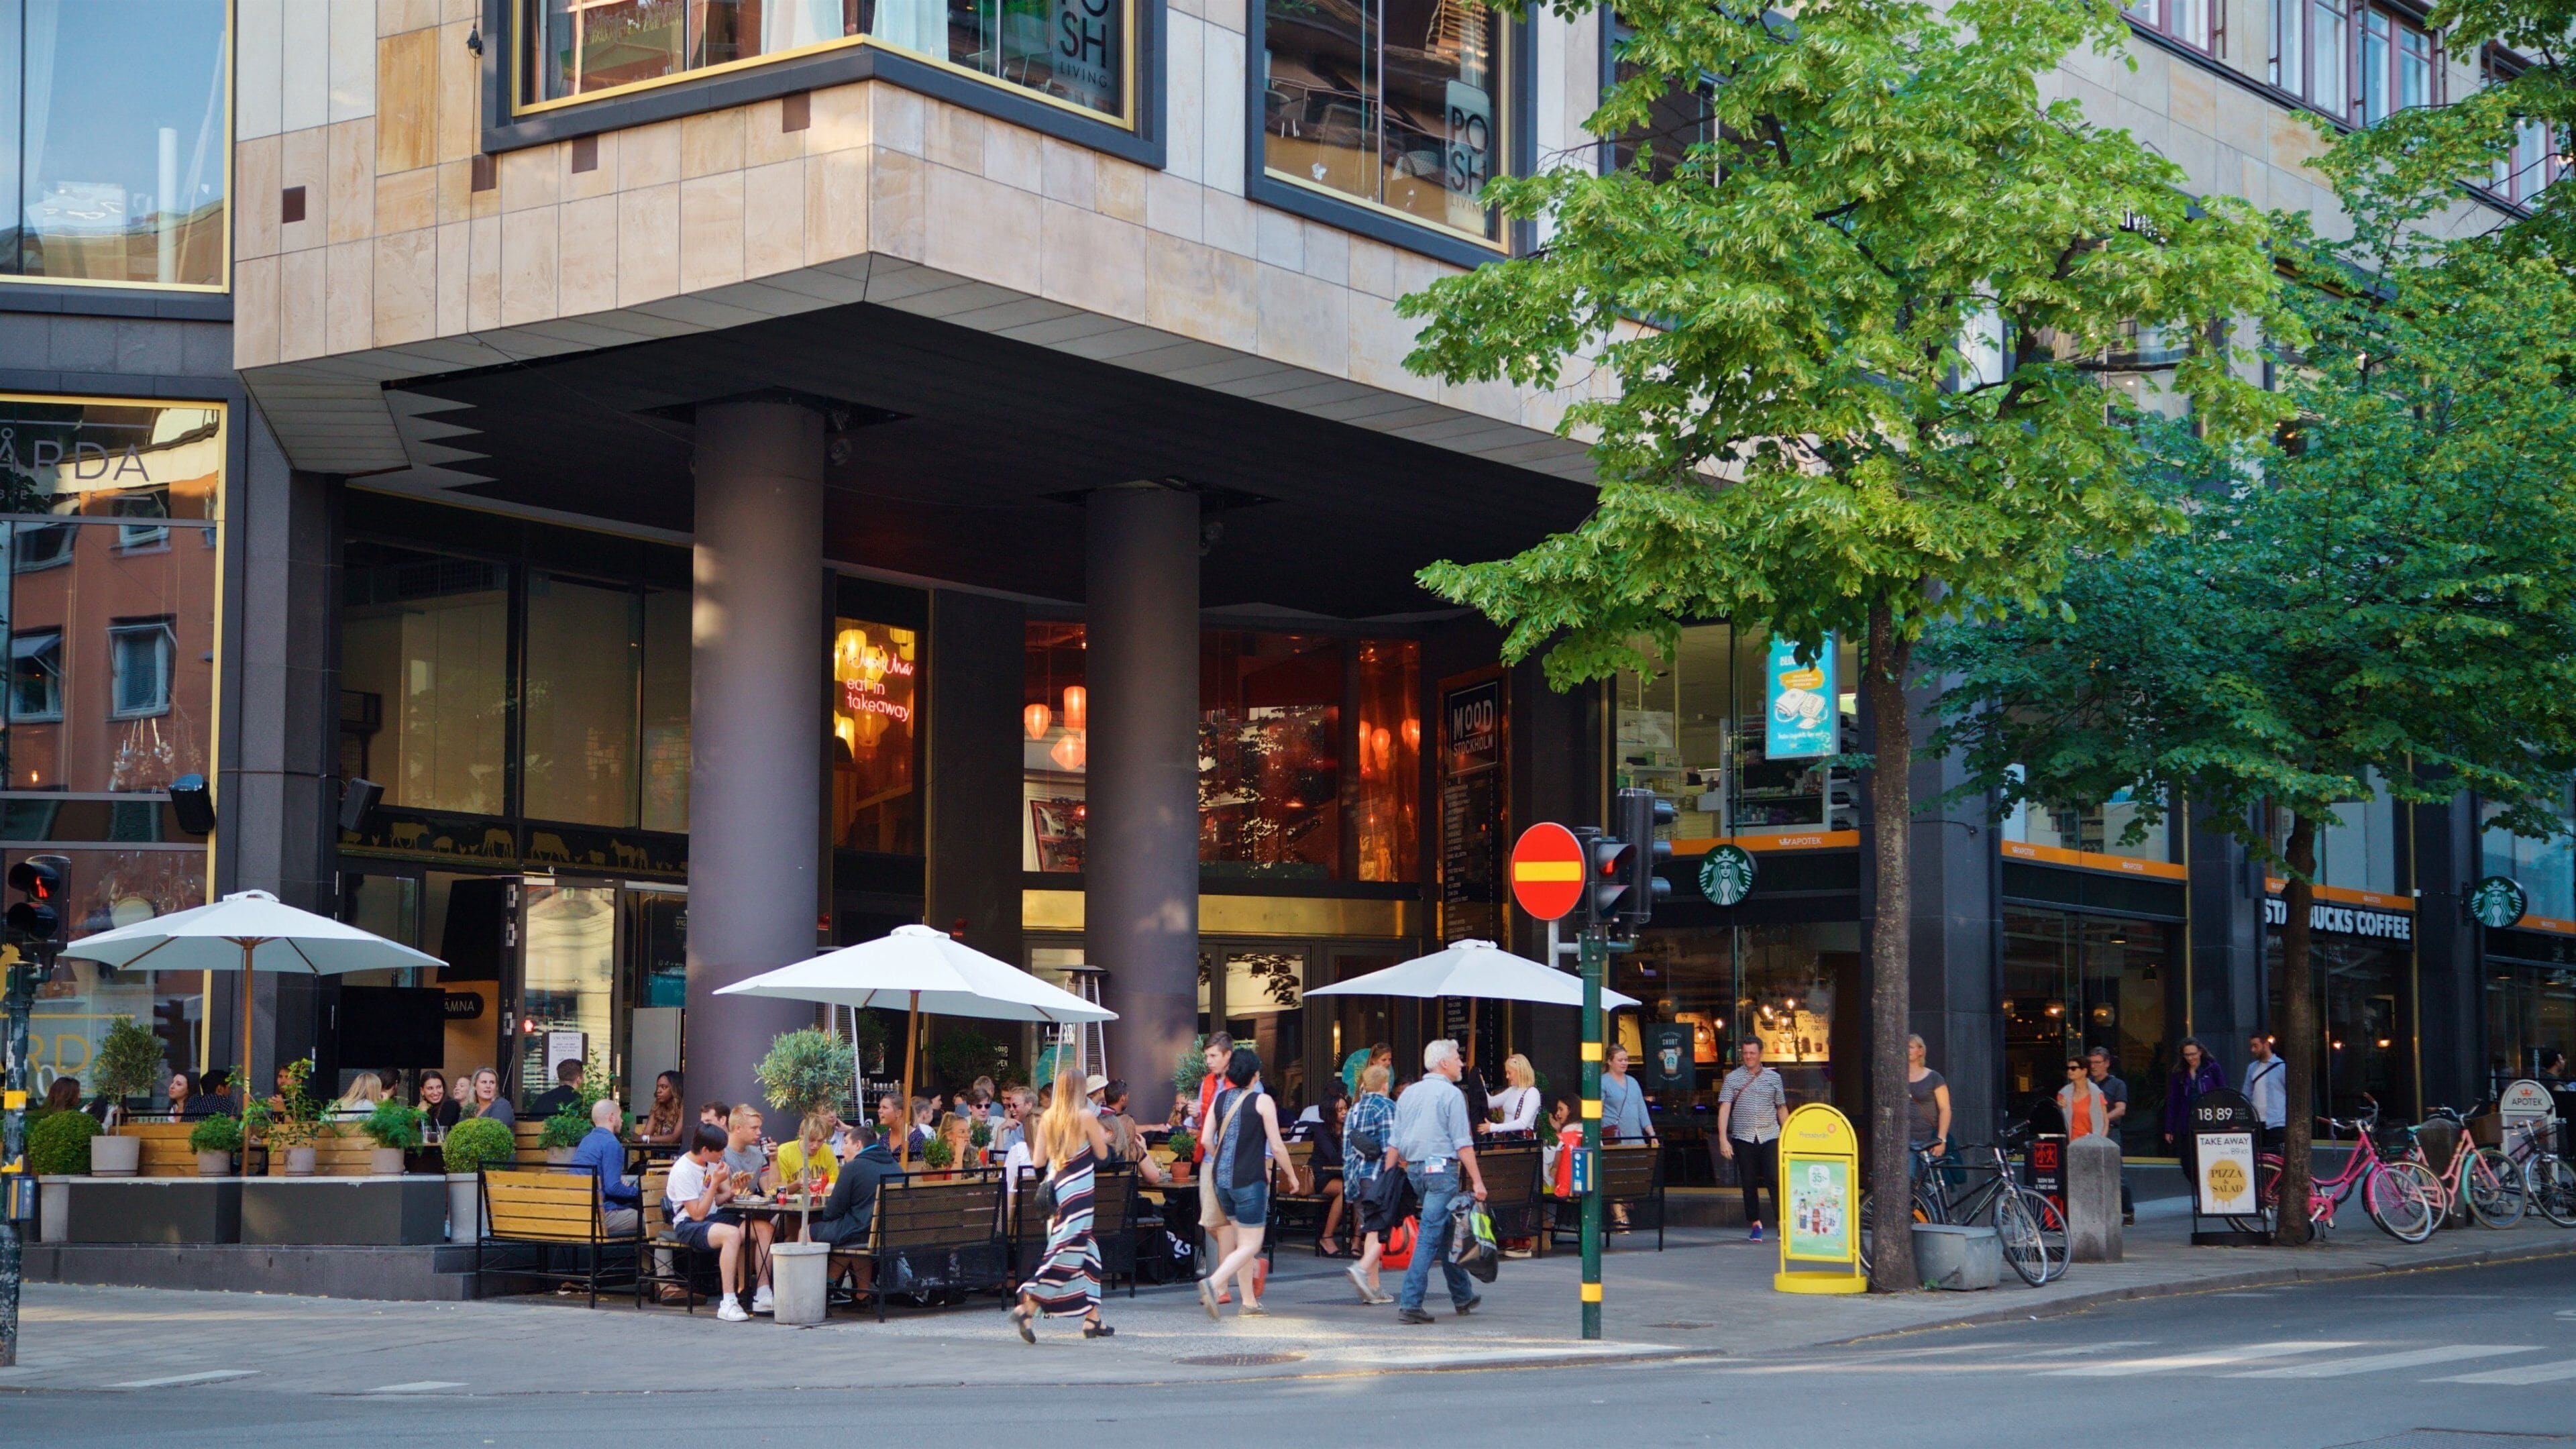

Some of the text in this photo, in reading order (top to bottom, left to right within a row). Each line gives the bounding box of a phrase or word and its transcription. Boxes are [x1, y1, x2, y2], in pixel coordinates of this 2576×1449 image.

[1061, 11, 1106, 68] SH
[1060, 62, 1107, 87] LIVING
[1452, 106, 1489, 154] PO
[1452, 151, 1487, 195] SH
[1452, 196, 1485, 215] LIVIN
[847, 678, 885, 695] eat in
[847, 692, 910, 722] takeaway
[1454, 699, 1493, 741] MOOD
[1454, 734, 1493, 757] STOCKHOLM
[1791, 837, 1823, 845] APOTEK
[2265, 899, 2410, 939] STUCKS COFFEE
[2211, 1169, 2242, 1178] PIZZA
